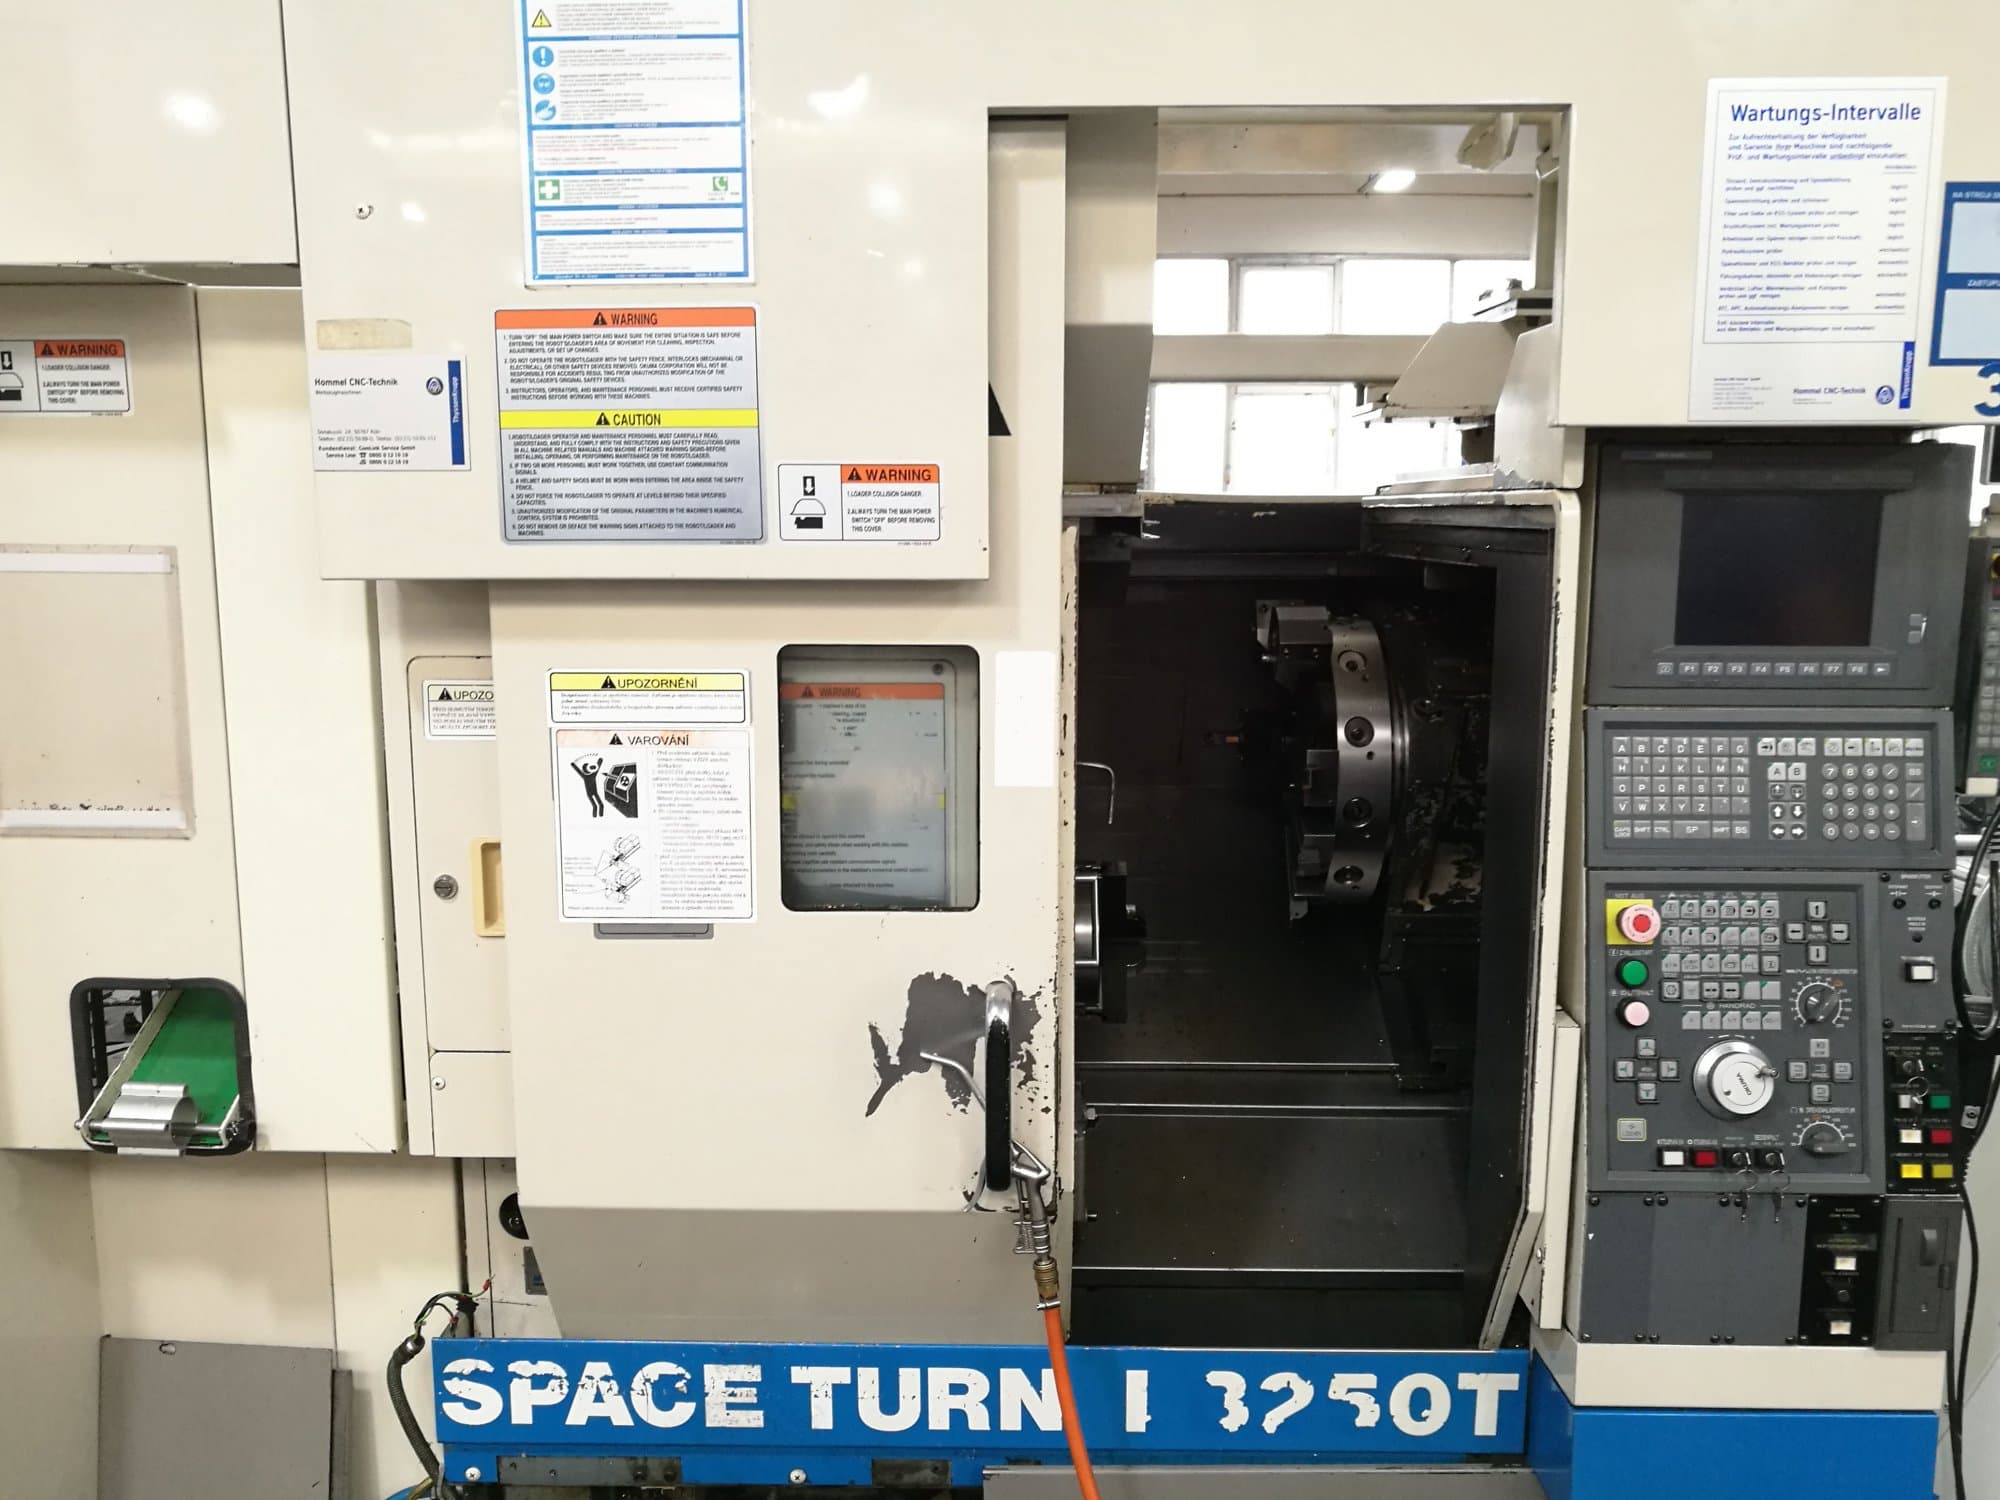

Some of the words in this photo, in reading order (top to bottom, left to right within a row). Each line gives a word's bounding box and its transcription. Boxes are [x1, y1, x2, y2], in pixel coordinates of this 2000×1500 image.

[1731, 103, 1921, 126] Wartungs-Intervalle
[611, 312, 658, 326] WARNING
[57, 344, 118, 356] WARNING
[314, 378, 346, 386] Hommel
[349, 378, 398, 386] CNC-Technik
[614, 413, 661, 426] CAUTION
[866, 469, 931, 481] WARNING
[820, 688, 860, 697] WARNING
[628, 734, 689, 746] VAROVÁNÍ
[1618, 745, 1626, 753] A
[1638, 745, 1645, 753] B
[1658, 745, 1665, 753] C
[1678, 745, 1684, 753] D
[1697, 745, 1704, 753] E
[1717, 745, 1723, 753] F
[1736, 745, 1744, 753] G
[1618, 765, 1626, 773] H
[1658, 765, 1665, 773] J
[1678, 765, 1685, 773] K
[1698, 765, 1704, 773] L
[1717, 765, 1725, 773] M
[1737, 765, 1744, 773] N
[1619, 784, 1626, 792] O
[1639, 784, 1645, 792] P
[1658, 784, 1666, 792] Q
[1678, 784, 1685, 792] R
[1698, 784, 1704, 792] S
[1717, 784, 1724, 792] T
[1737, 784, 1744, 792] U
[1619, 803, 1626, 811] V
[1638, 803, 1647, 811] W
[1658, 803, 1666, 811] X
[1678, 803, 1686, 811] Y
[1698, 803, 1704, 811] Z
[1736, 1072, 1752, 1096] OKUMA
[442, 1358, 764, 1428] SPACE
[790, 1366, 1063, 1432] TURN
